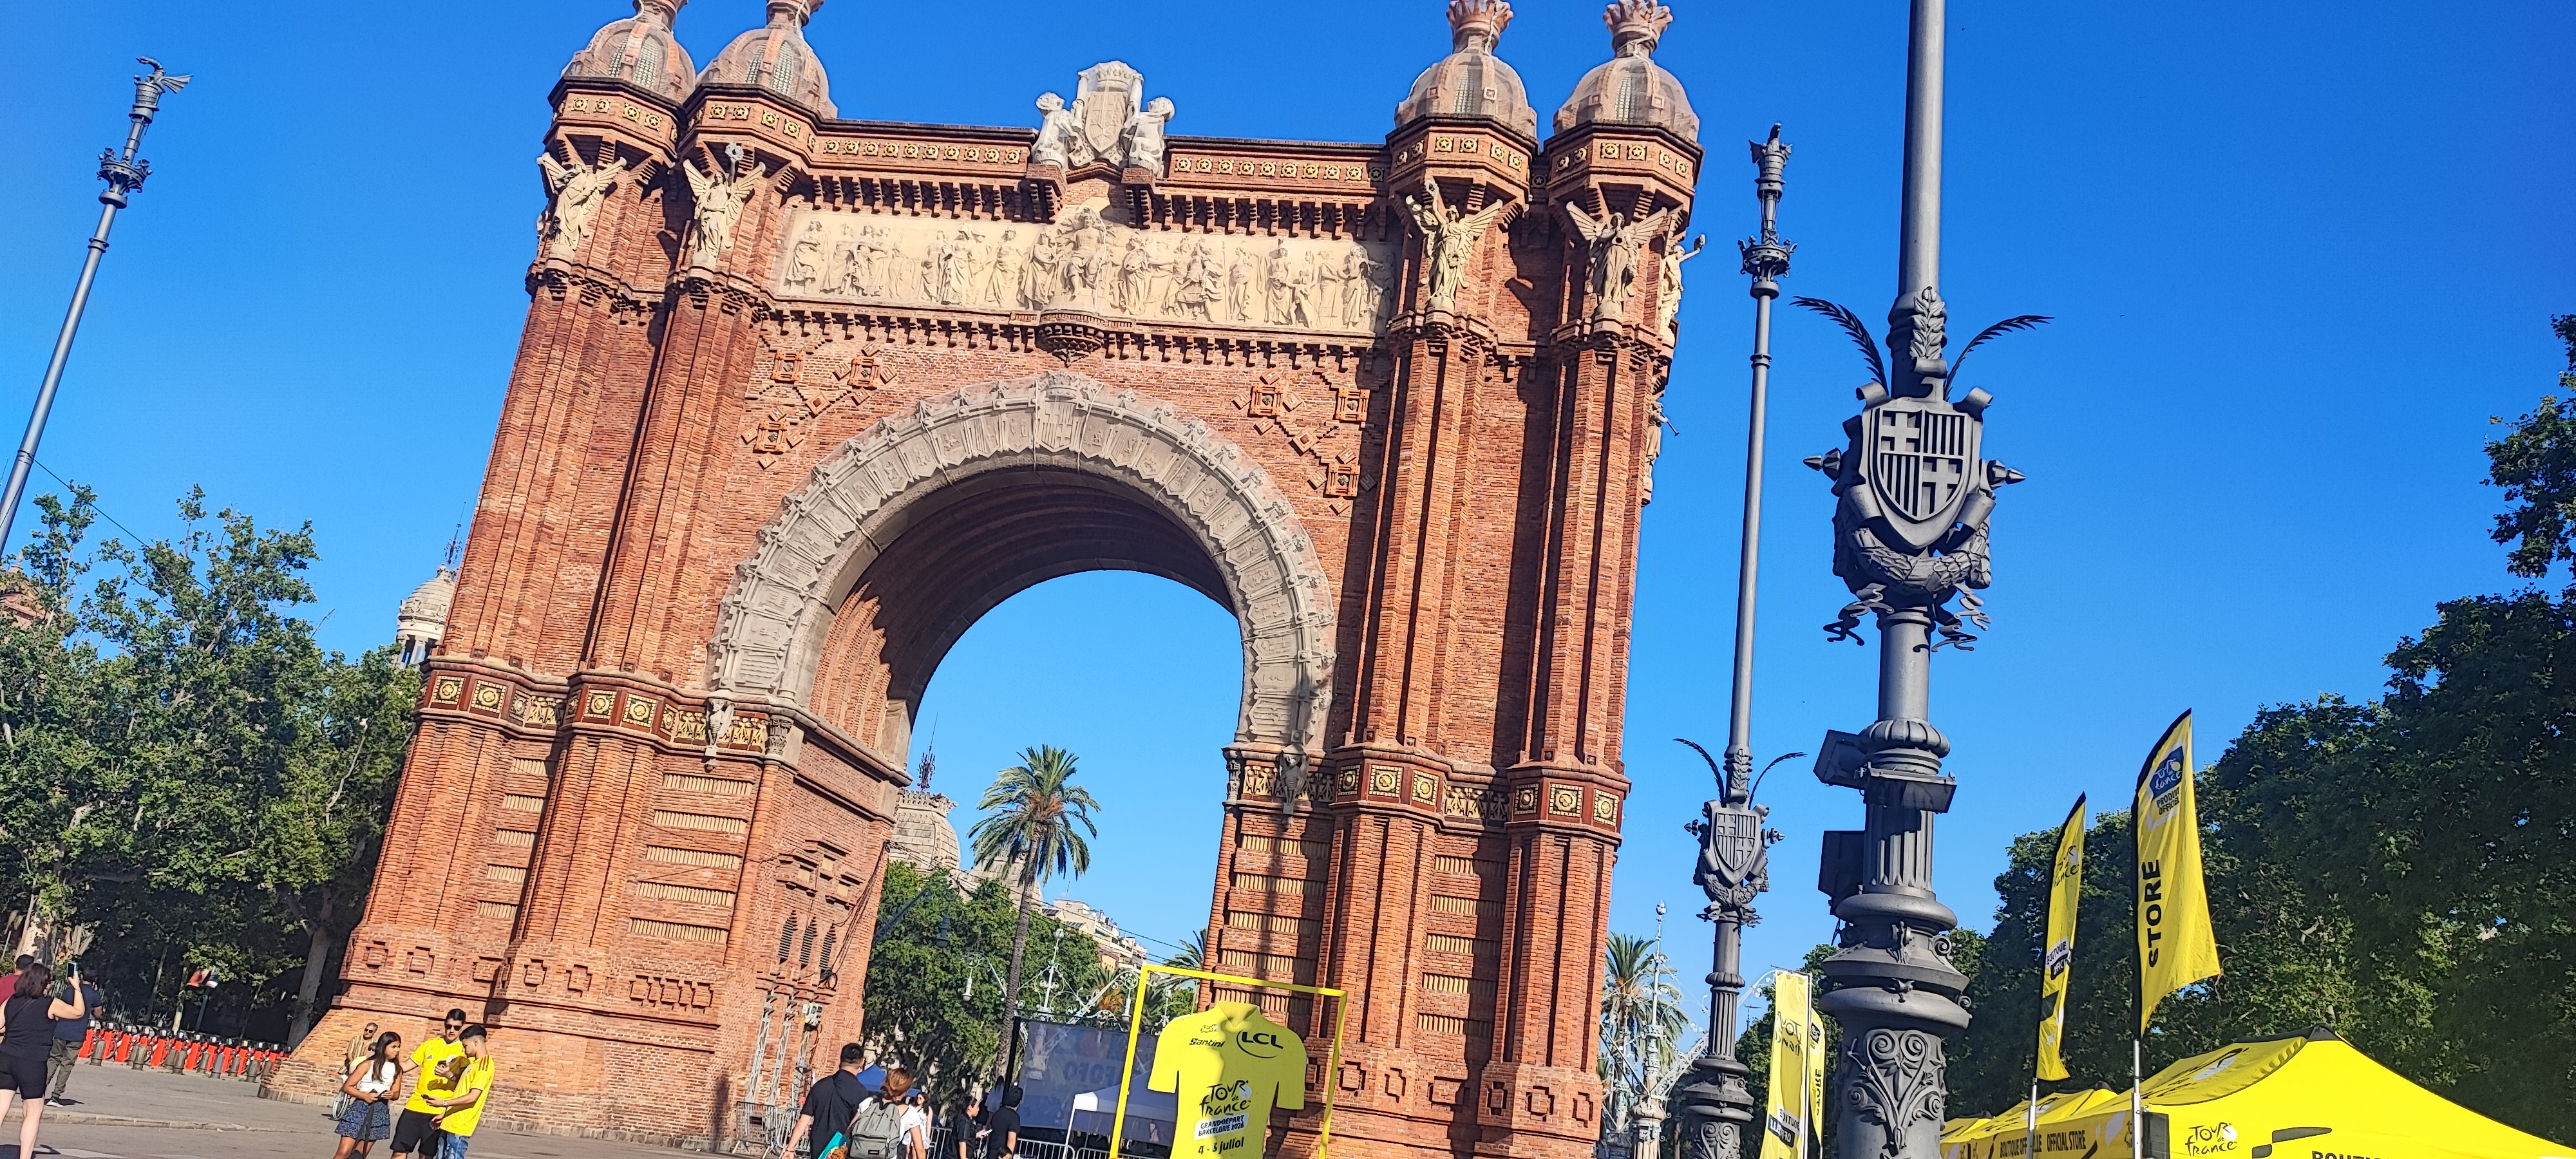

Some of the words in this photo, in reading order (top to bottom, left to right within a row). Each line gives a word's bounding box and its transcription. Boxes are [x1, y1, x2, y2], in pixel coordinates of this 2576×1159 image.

[2156, 786, 2180, 808] PRODUIT
[2159, 796, 2180, 816] OFFICIEL
[2141, 859, 2162, 968] STORE
[1189, 1038, 1226, 1048] Santini
[1242, 1032, 1283, 1050] LCL
[1198, 1145, 1204, 1154] 4
[1218, 1136, 1245, 1154] juliol
[2020, 1135, 2042, 1155] OFFLLE
[2047, 1131, 2068, 1152] OFFICIAL
[2069, 1130, 2087, 1150] STORE
